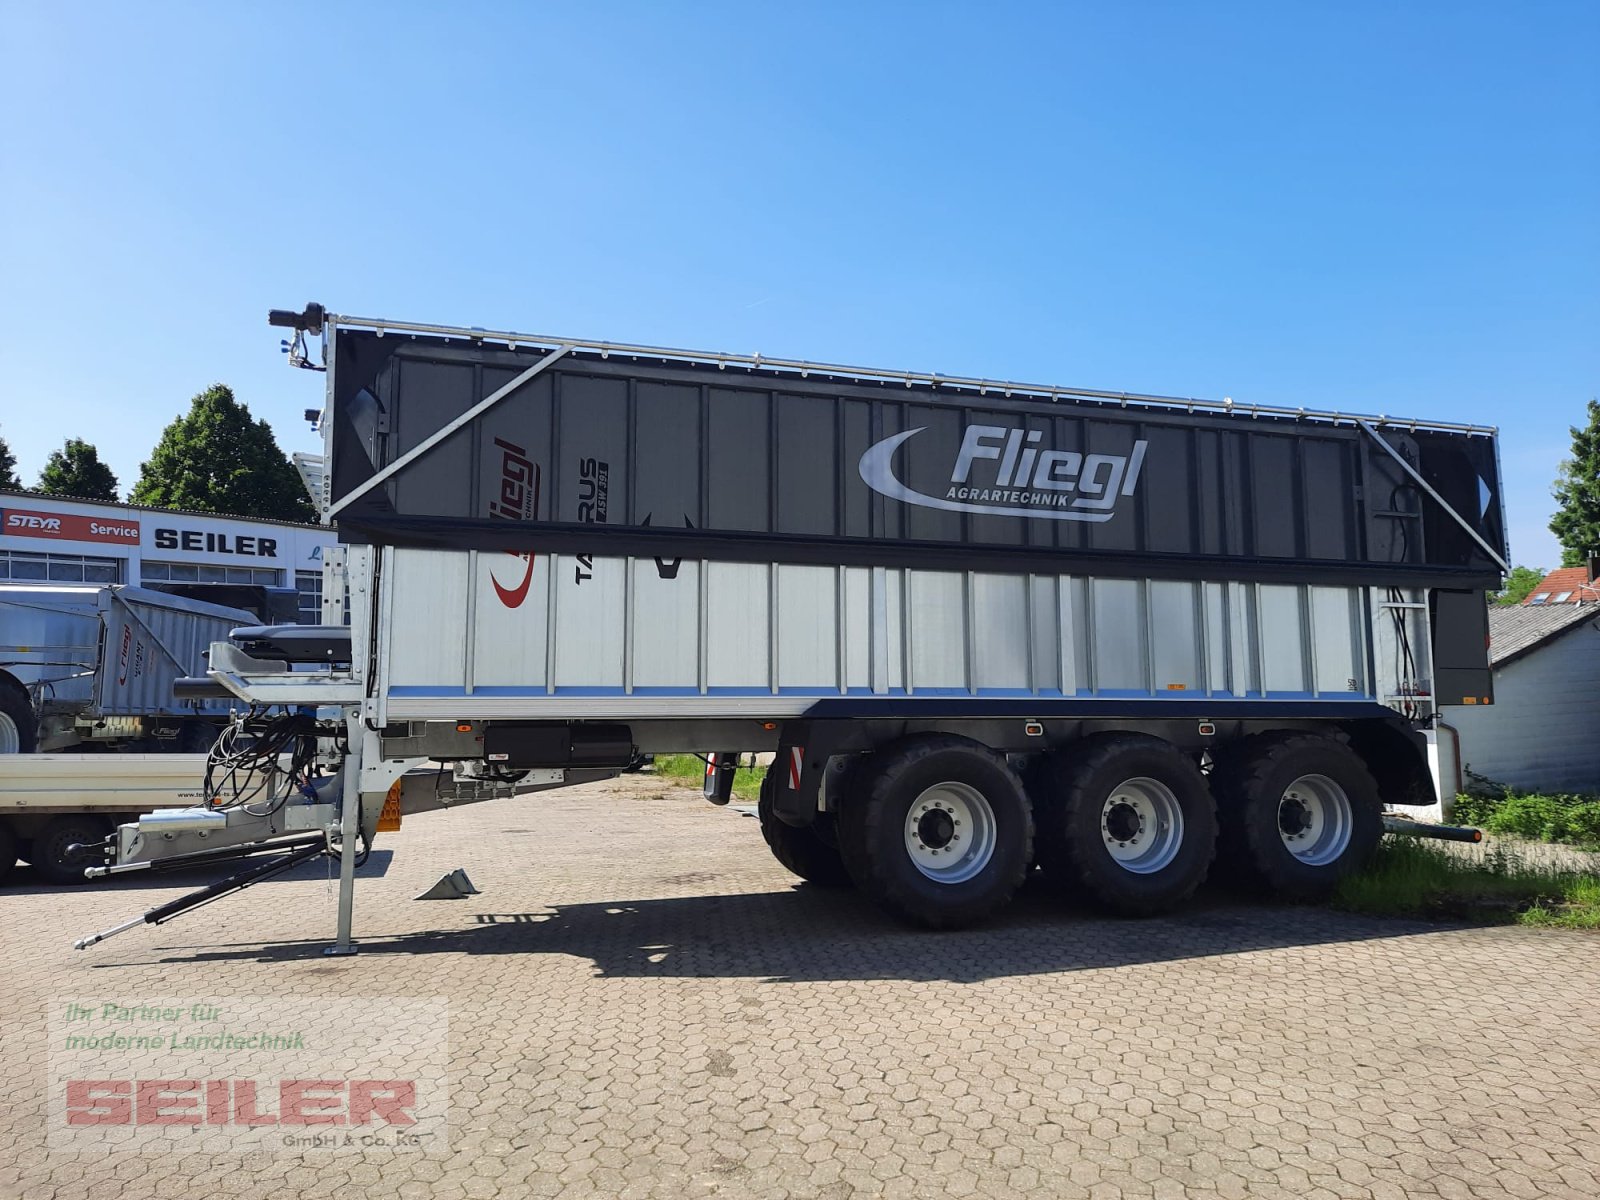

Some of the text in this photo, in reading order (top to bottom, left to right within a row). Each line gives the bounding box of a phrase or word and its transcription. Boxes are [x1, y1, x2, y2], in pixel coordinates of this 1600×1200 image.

[951, 424, 1149, 509] Fliegl
[597, 490, 607, 516] ASW
[946, 486, 1069, 507] AGRARTECHNIK
[7, 514, 61, 530] STEYR
[90, 522, 138, 538] Service
[575, 457, 597, 586] TARUS
[155, 528, 278, 558] SEILER
